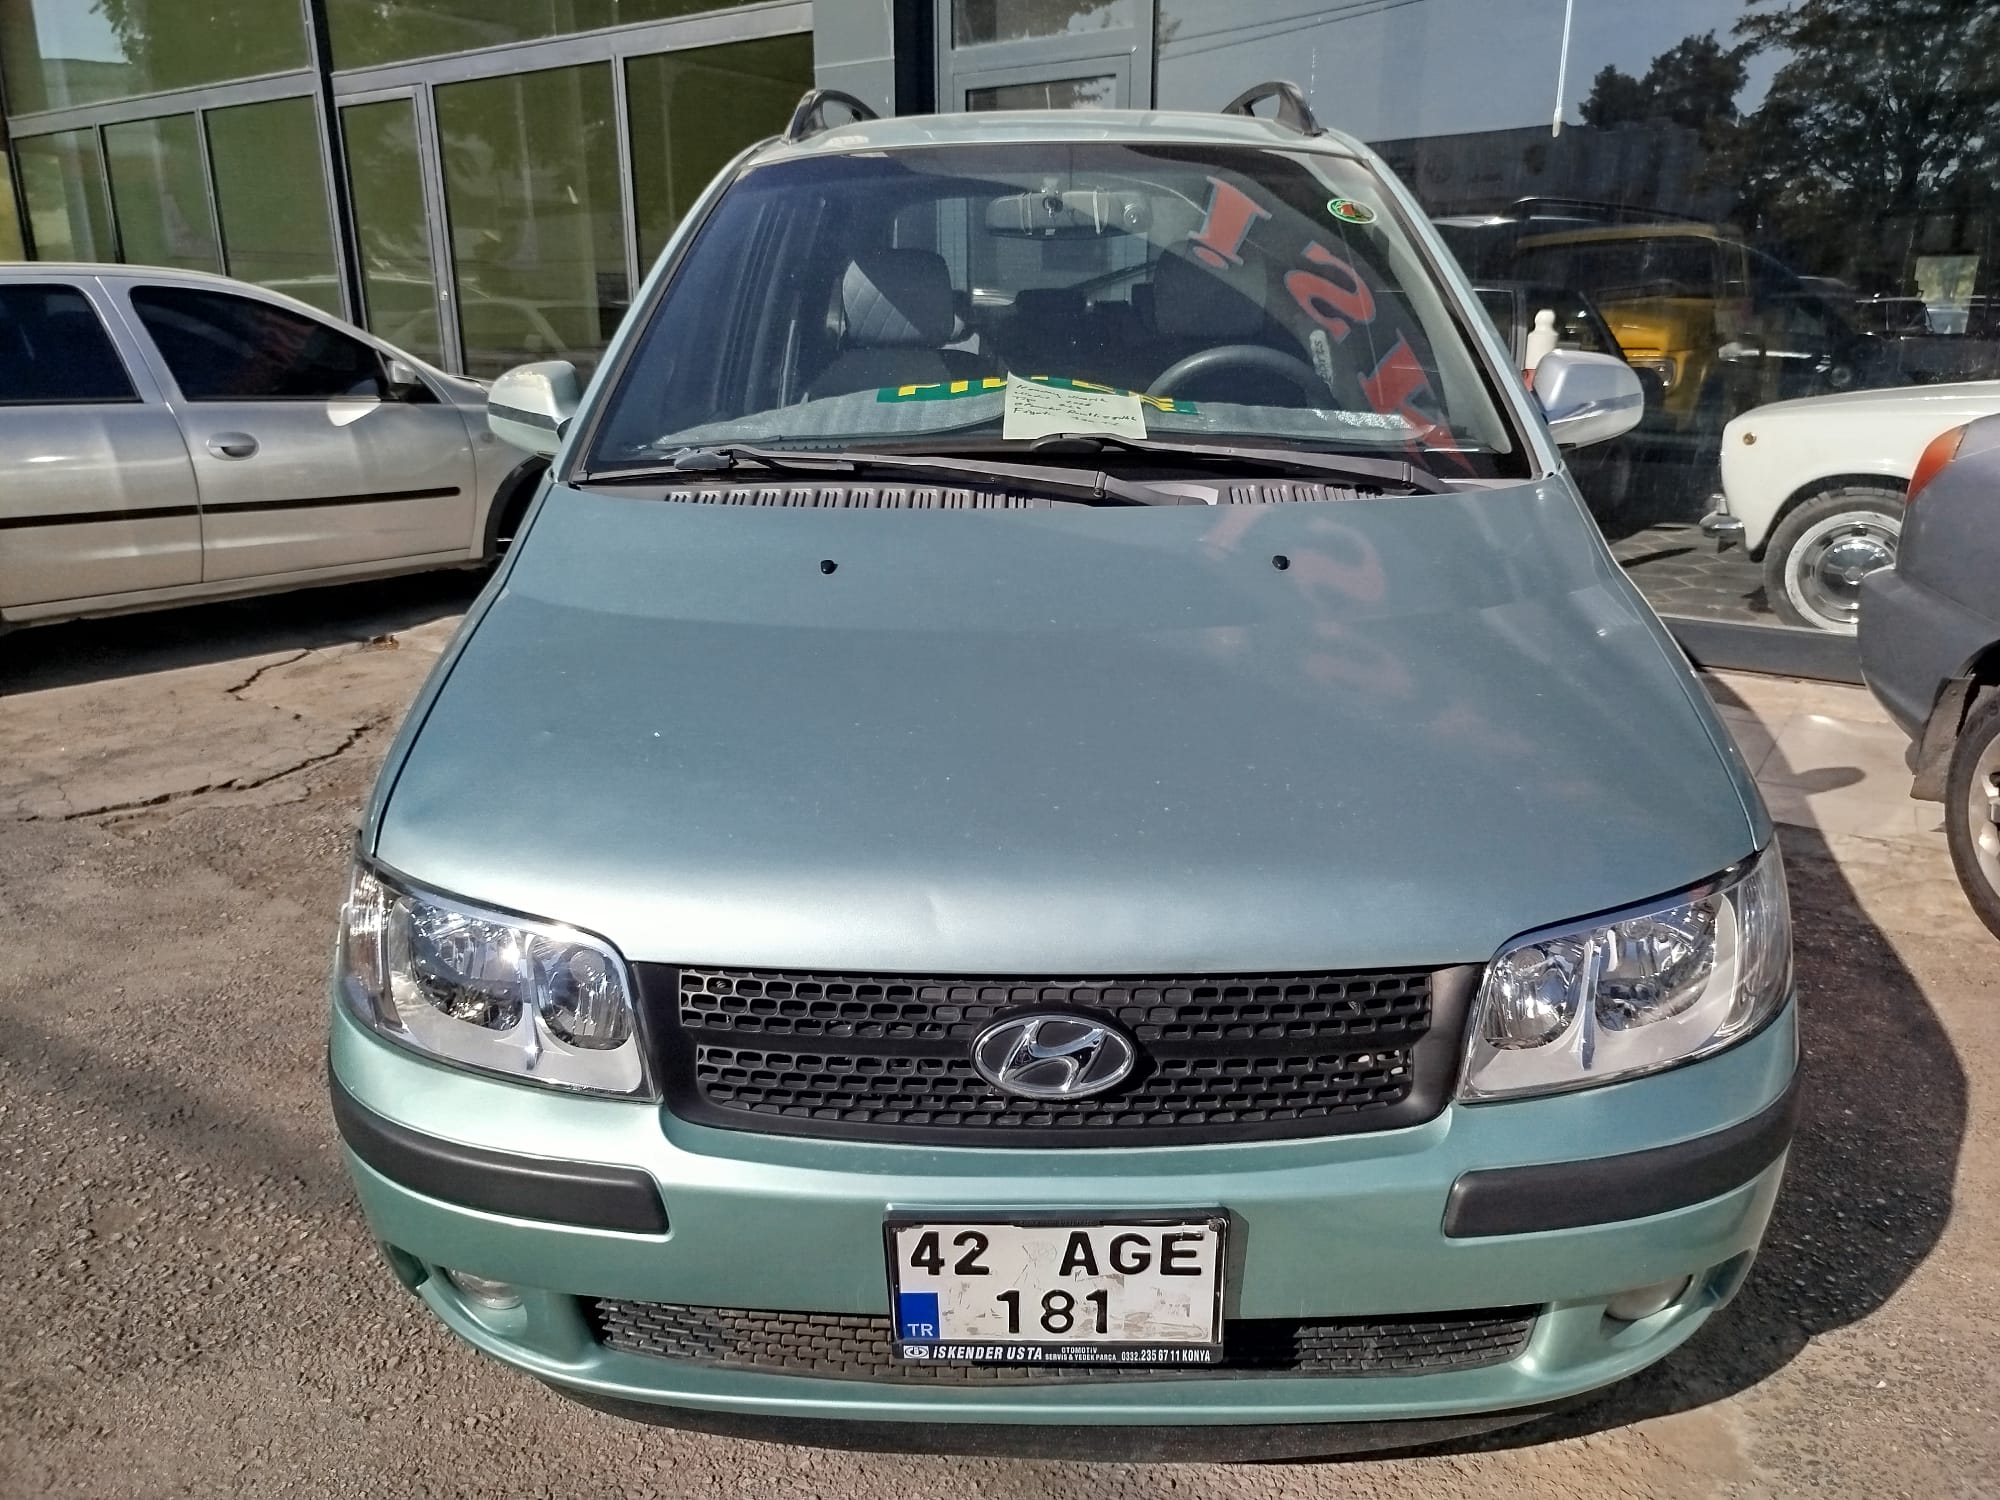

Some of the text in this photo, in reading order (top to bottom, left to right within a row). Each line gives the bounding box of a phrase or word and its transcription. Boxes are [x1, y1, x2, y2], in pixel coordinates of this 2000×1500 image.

[910, 1231, 1205, 1276] 42 AGE
[996, 1289, 1109, 1334] 181
[907, 1323, 934, 1338] TR
[1006, 1346, 1042, 1361] USTA
[1170, 1350, 1180, 1361] 11
[1182, 1349, 1211, 1362] KONYA
